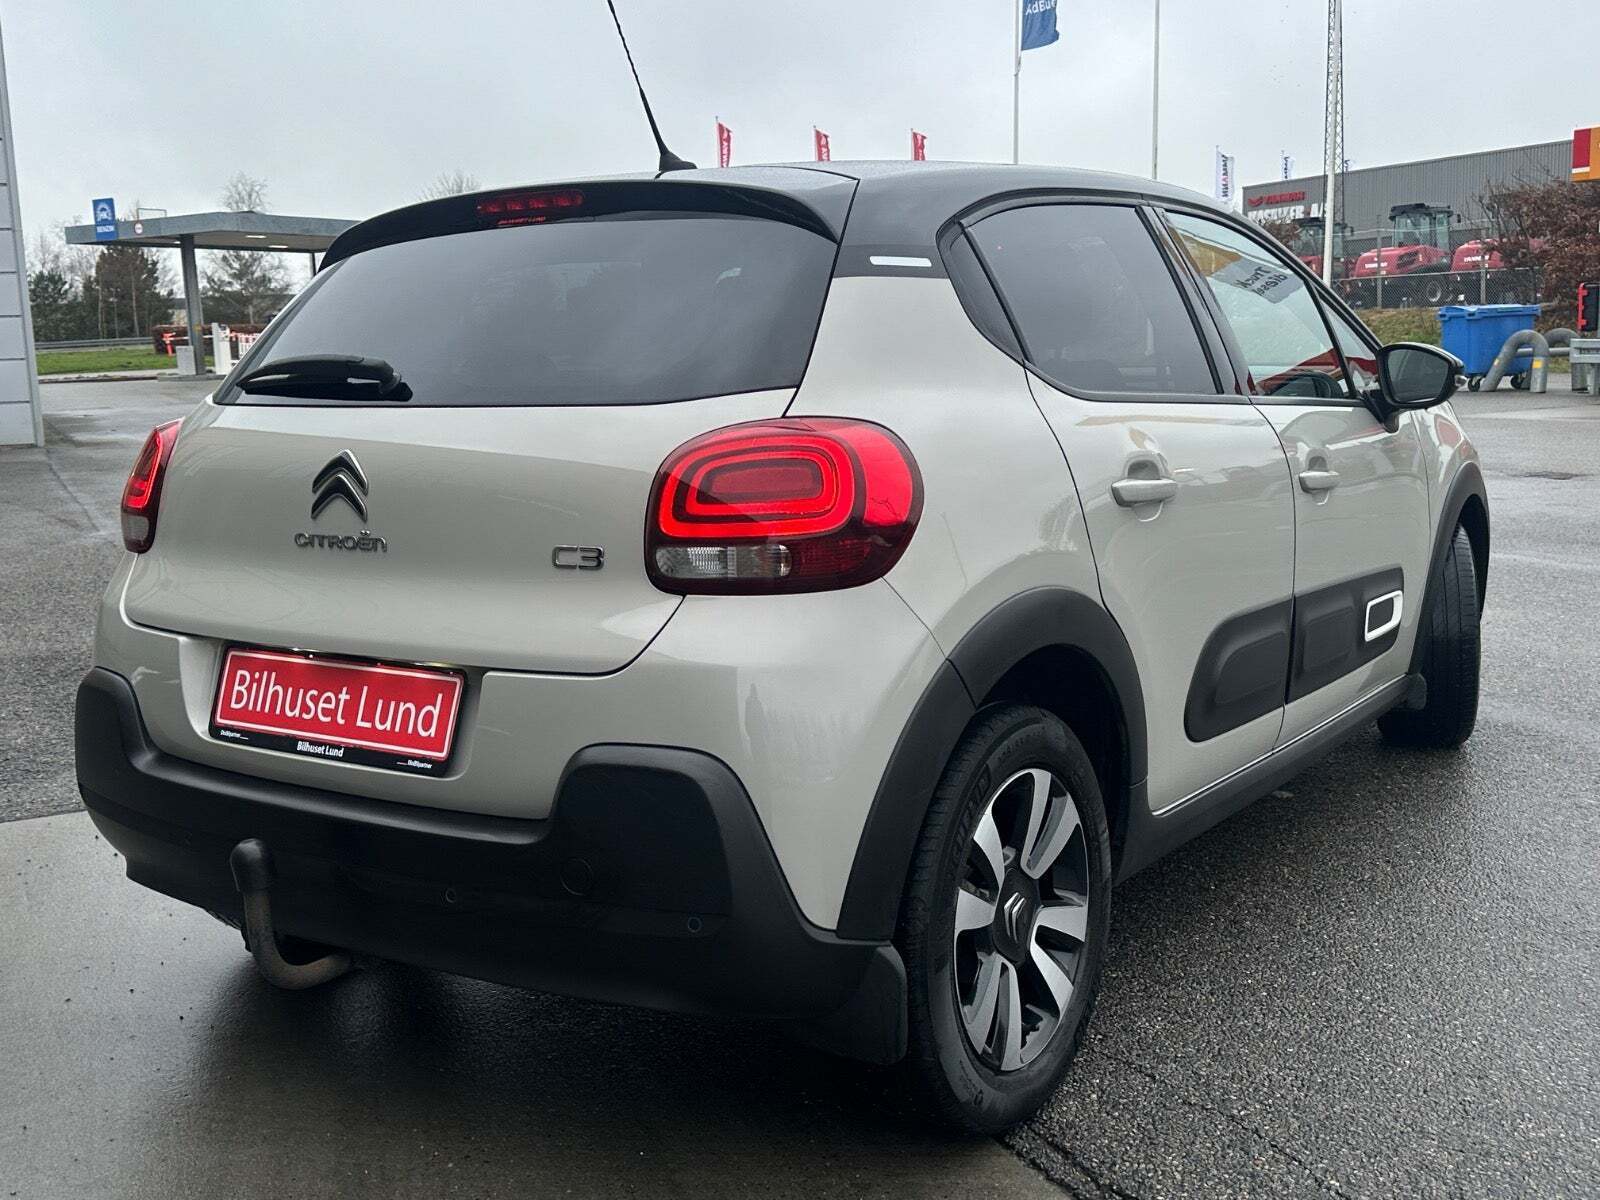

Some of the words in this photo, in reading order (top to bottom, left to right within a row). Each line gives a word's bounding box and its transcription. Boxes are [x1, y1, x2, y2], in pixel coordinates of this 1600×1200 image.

[551, 544, 605, 571] C3
[230, 669, 351, 725] Bilhuset
[355, 685, 443, 738] Lund
[296, 740, 325, 755] Bilhuset
[325, 745, 345, 757] Lund
